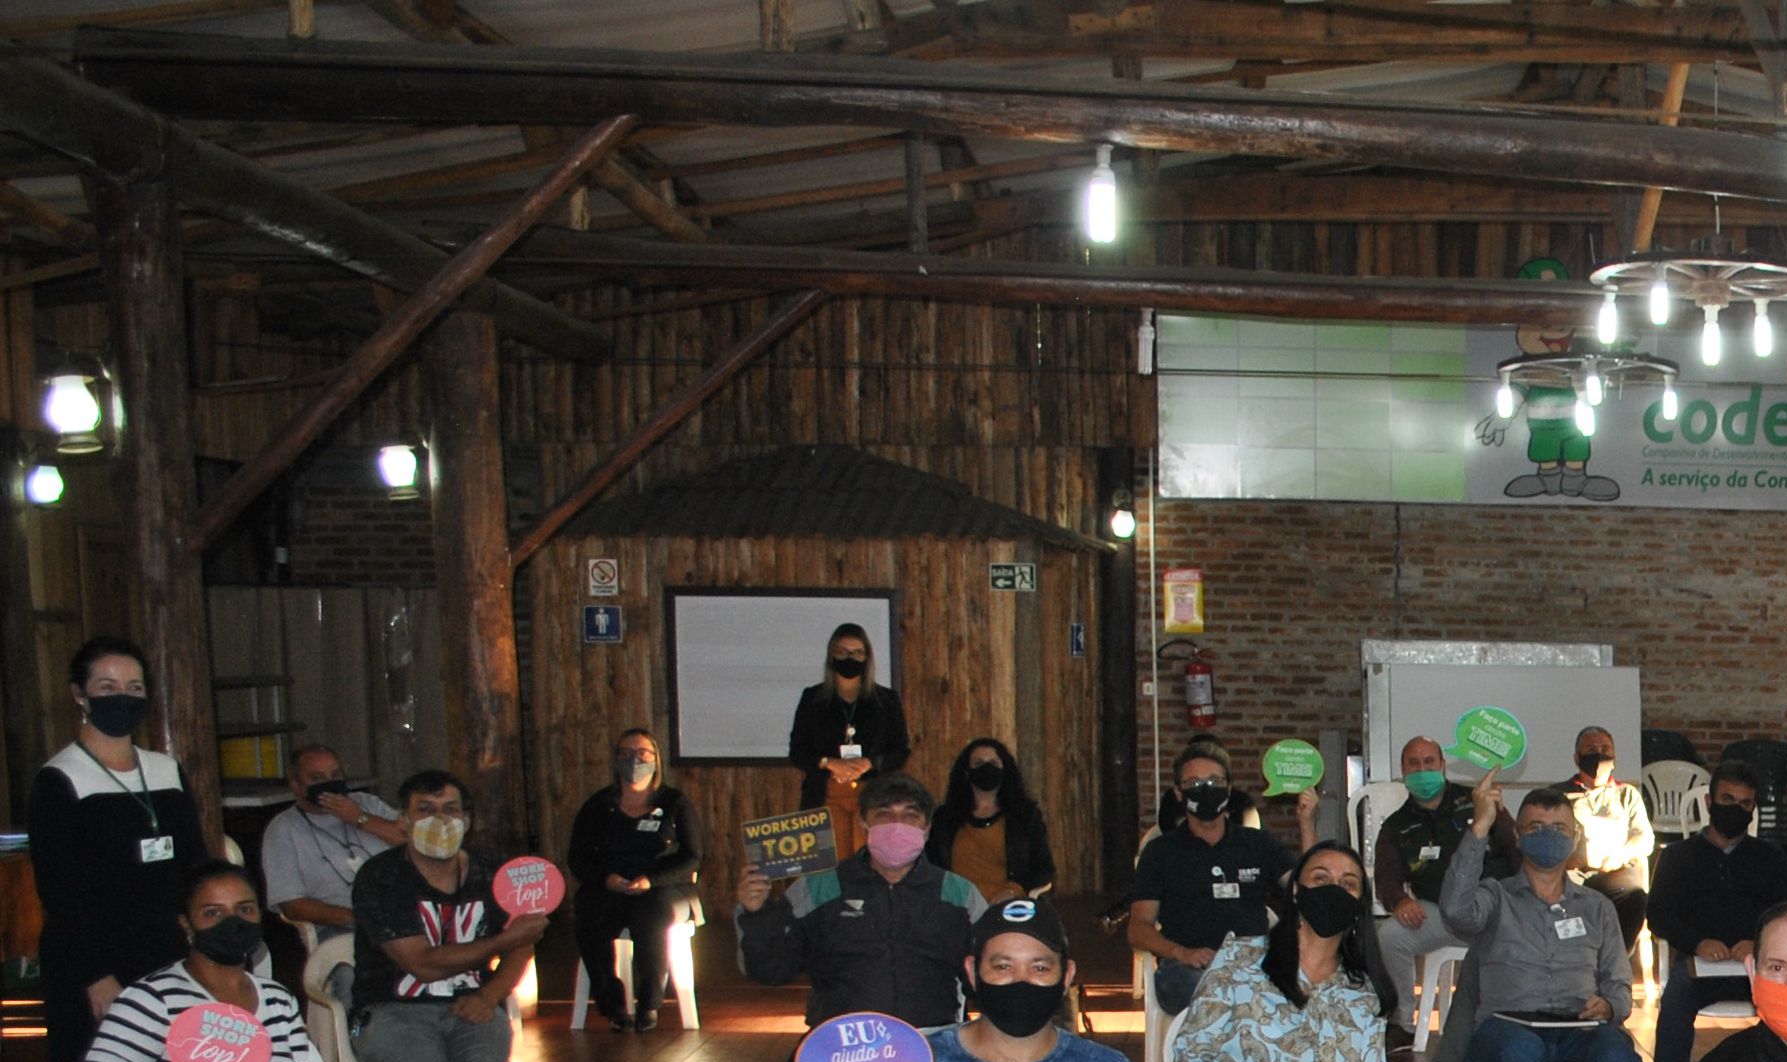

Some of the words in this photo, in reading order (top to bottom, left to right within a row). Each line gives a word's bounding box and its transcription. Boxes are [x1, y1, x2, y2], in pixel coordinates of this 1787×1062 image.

[1641, 468, 1654, 486] A
[1659, 470, 1720, 492] serviço
[1726, 470, 1748, 488] da
[746, 812, 828, 838] WORKSHOP
[763, 832, 816, 859] TOP
[506, 862, 545, 878] WORK
[511, 872, 545, 887] SHOP
[516, 879, 548, 909] top!
[201, 1023, 251, 1046] SHOP
[203, 1009, 257, 1037] WORK
[838, 1020, 877, 1047] EU
[883, 1044, 897, 1059] a
